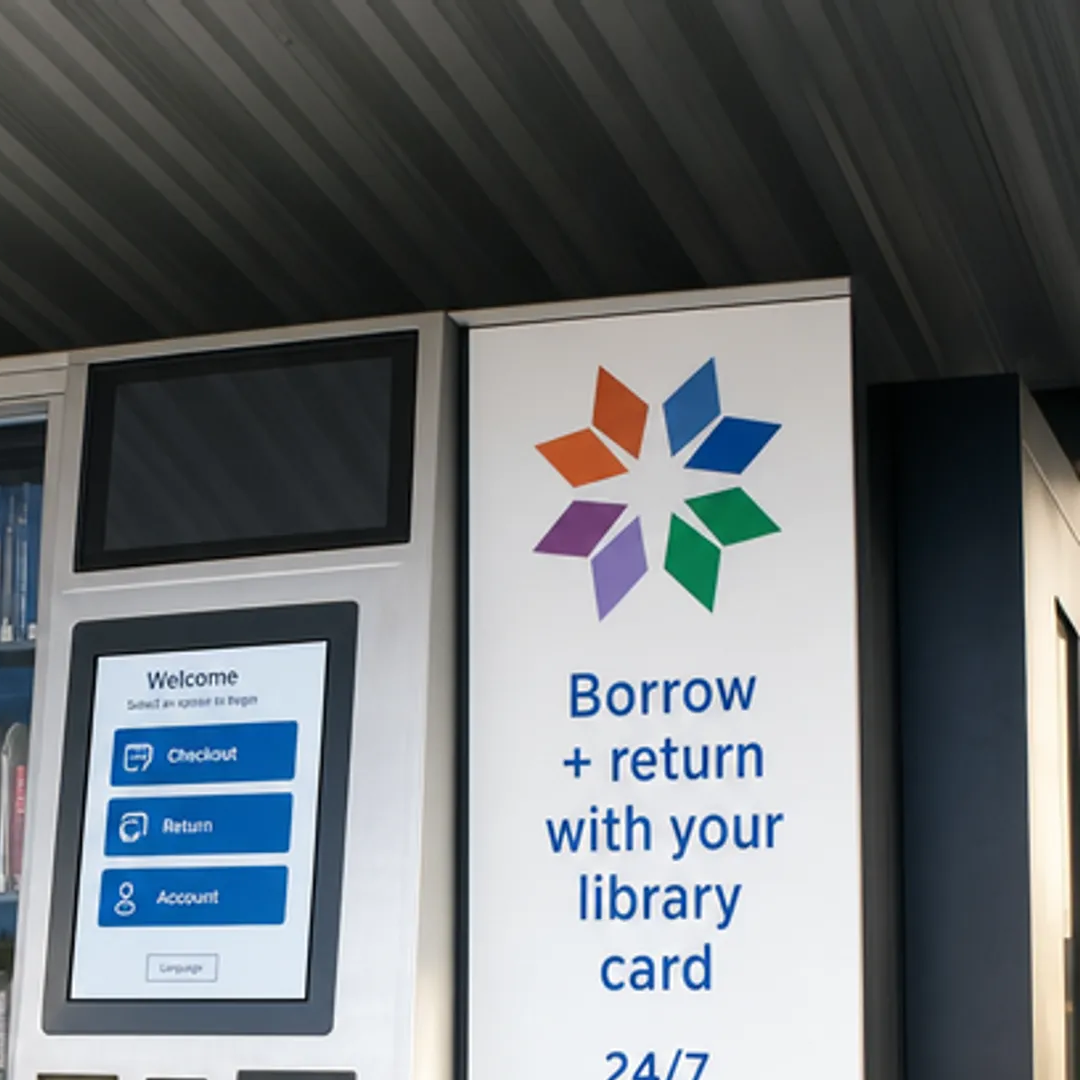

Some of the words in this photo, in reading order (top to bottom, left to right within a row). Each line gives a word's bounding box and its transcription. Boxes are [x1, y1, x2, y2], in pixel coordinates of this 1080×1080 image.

[146, 669, 239, 690] Welcome
[570, 672, 757, 719] Borrow
[166, 746, 238, 764] Checkout
[563, 747, 592, 779] +
[611, 737, 764, 783] return
[162, 817, 213, 834] Return
[545, 804, 652, 854] with
[669, 812, 785, 861] your
[155, 889, 219, 905] Account
[579, 873, 742, 931] library
[600, 942, 712, 992] card
